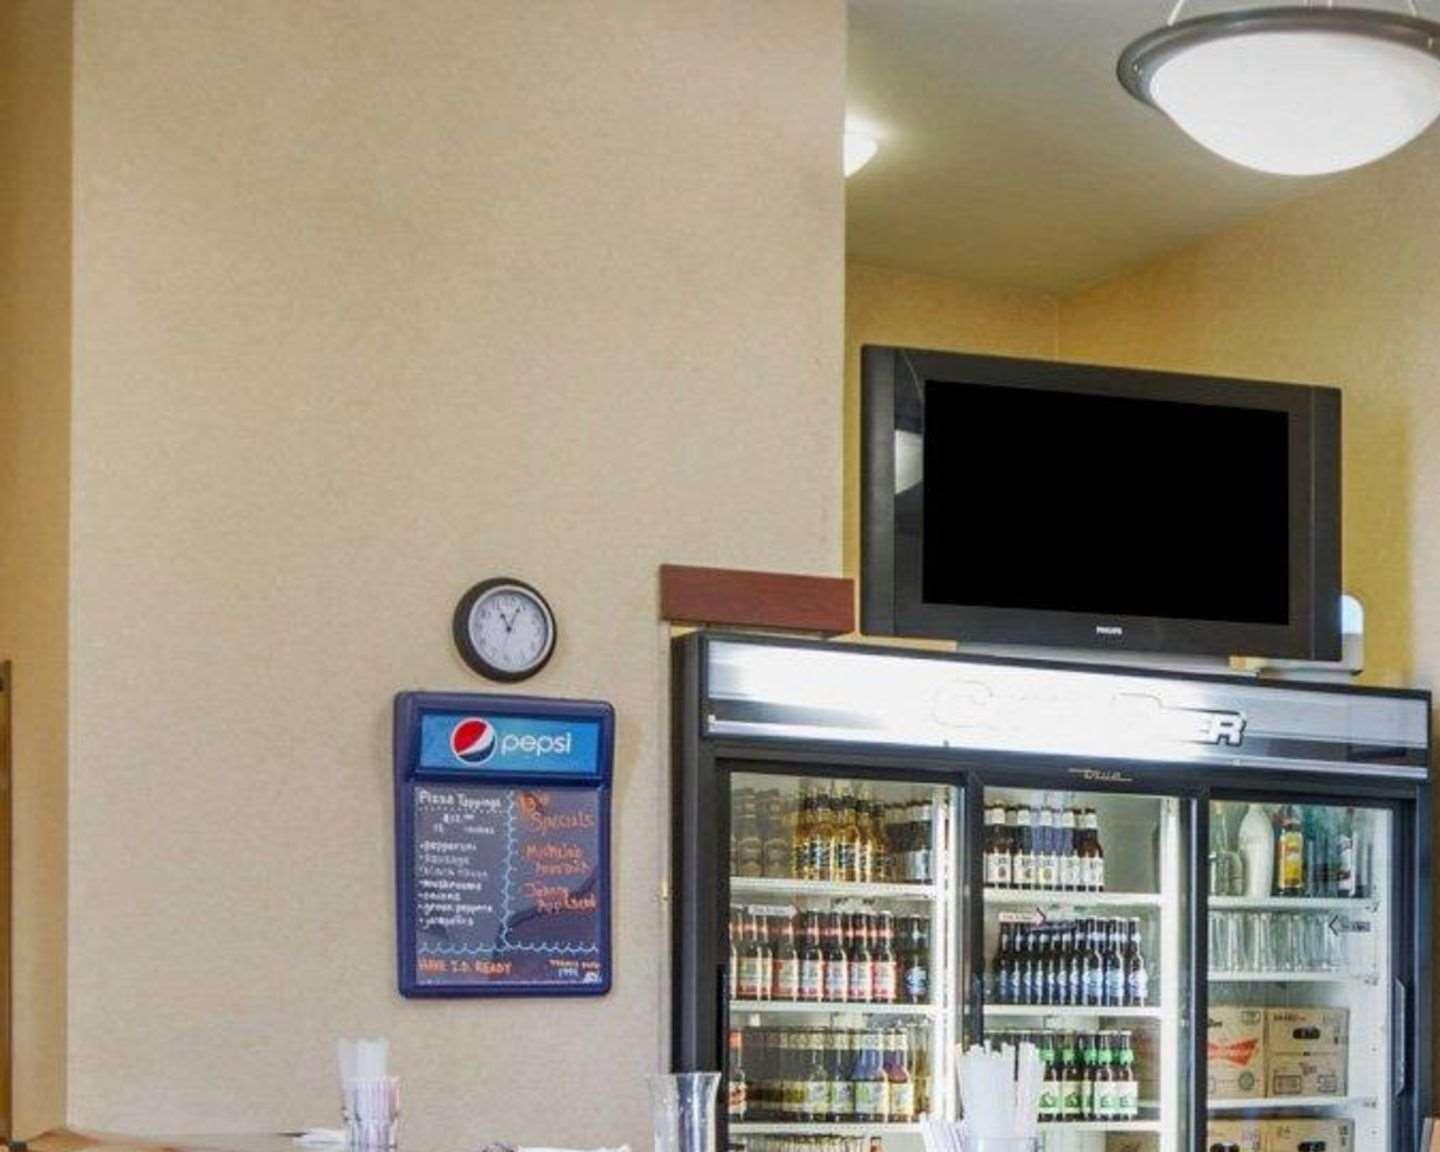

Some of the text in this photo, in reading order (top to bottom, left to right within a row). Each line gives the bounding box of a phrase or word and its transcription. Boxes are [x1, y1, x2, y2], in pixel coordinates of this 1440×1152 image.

[501, 730, 571, 756] pepsi
[419, 788, 455, 805] Pizza
[530, 812, 595, 834] Specials
[475, 959, 513, 975] READY
